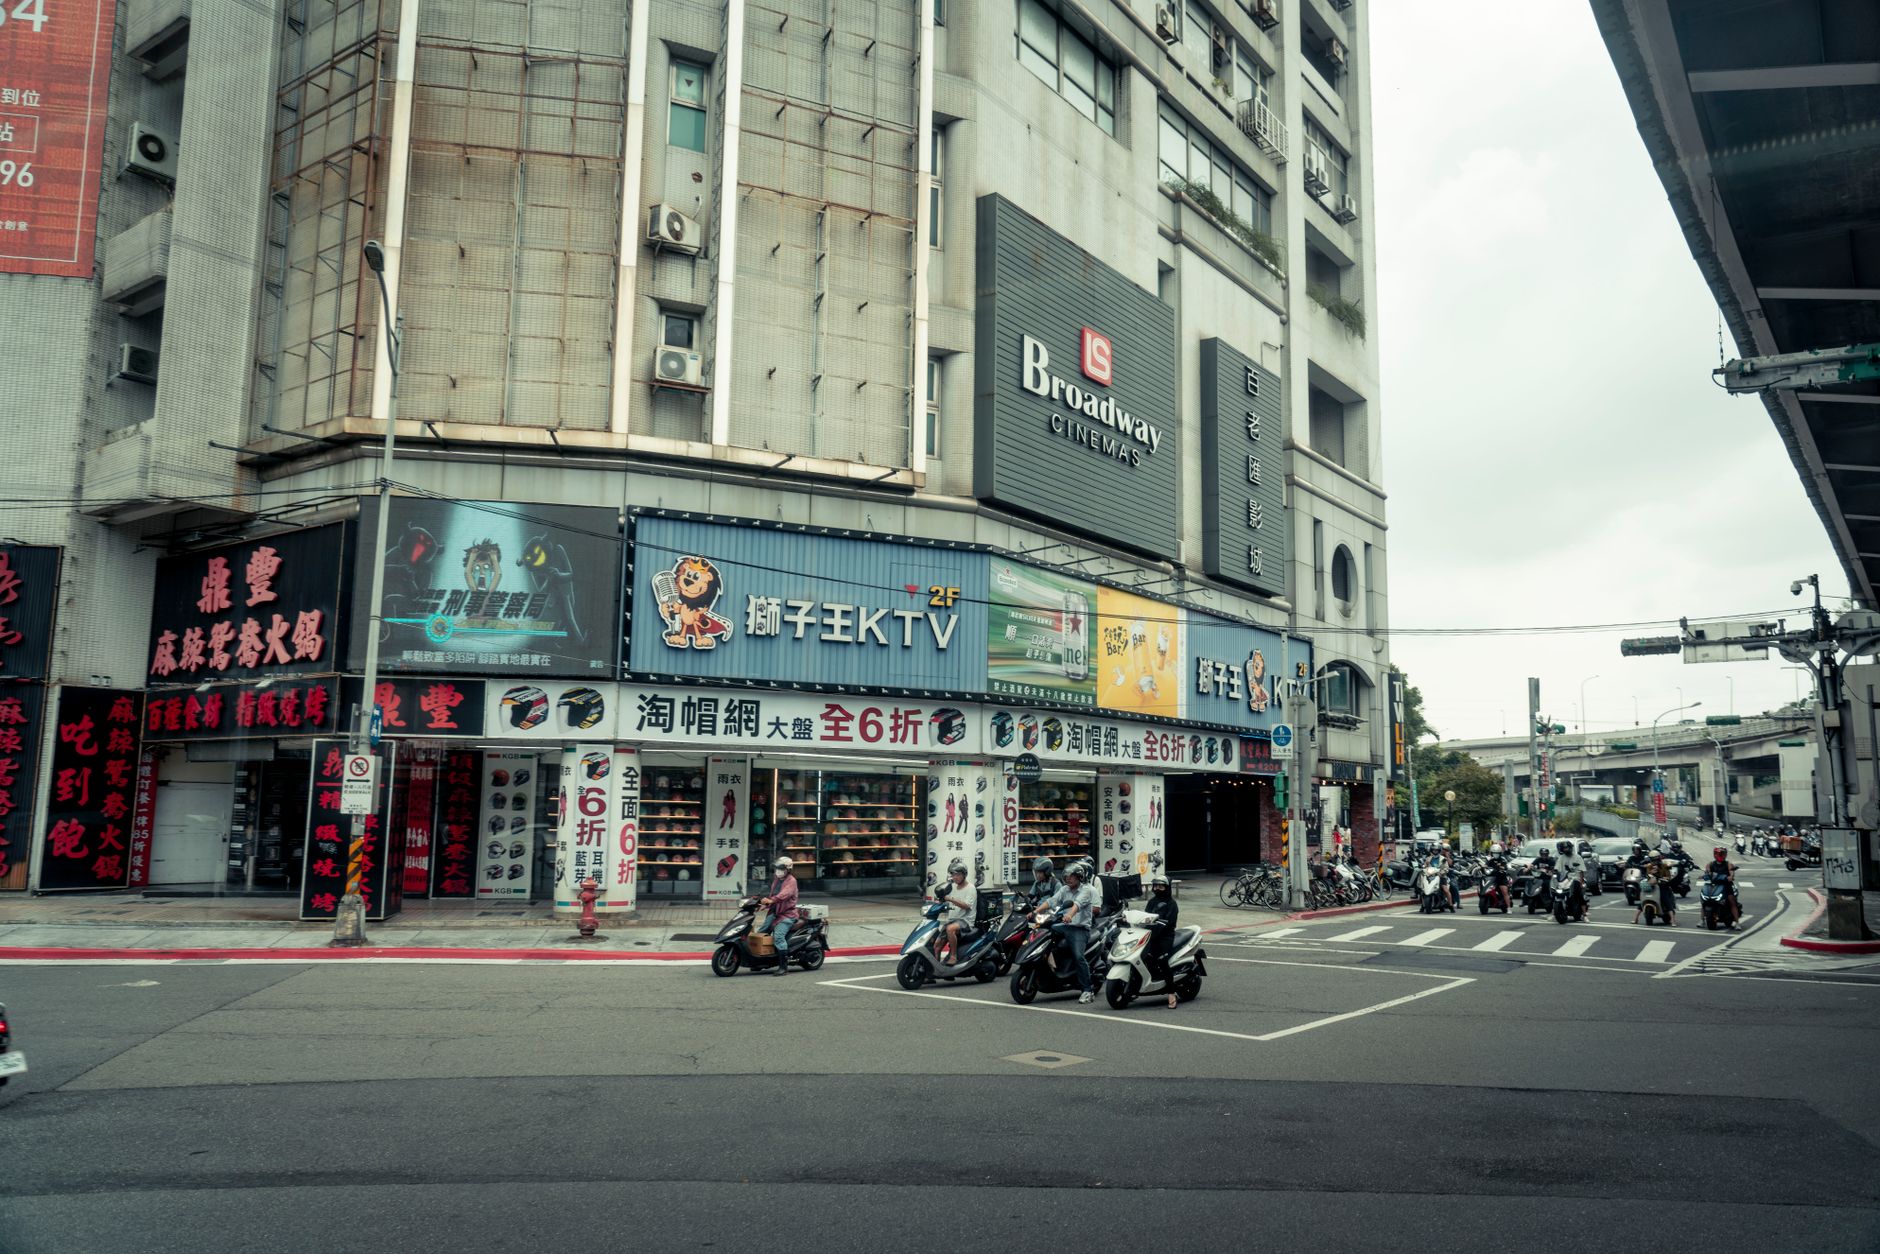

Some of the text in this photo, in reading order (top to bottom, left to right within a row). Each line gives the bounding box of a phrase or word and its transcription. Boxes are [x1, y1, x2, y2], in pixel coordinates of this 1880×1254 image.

[0, 0, 49, 32] 4
[0, 160, 34, 187] 96
[1022, 334, 1161, 453] Broadway
[1051, 414, 1141, 467] CINEMAS
[1245, 366, 1263, 576] 百老匯影城
[929, 585, 960, 607] 2F
[745, 594, 959, 649] 獅子王KTV
[636, 693, 923, 745] 淘帽網 大盤 全6折
[1066, 722, 1186, 764] 淘帽網 大盤 全6折
[48, 715, 98, 858] 吃到飽
[717, 773, 742, 785] 雨衣
[947, 776, 965, 787] 雨衣
[616, 766, 641, 884] 全面6折
[716, 838, 741, 849] 手套
[946, 840, 963, 851] 手套
[494, 886, 513, 895] KGB
